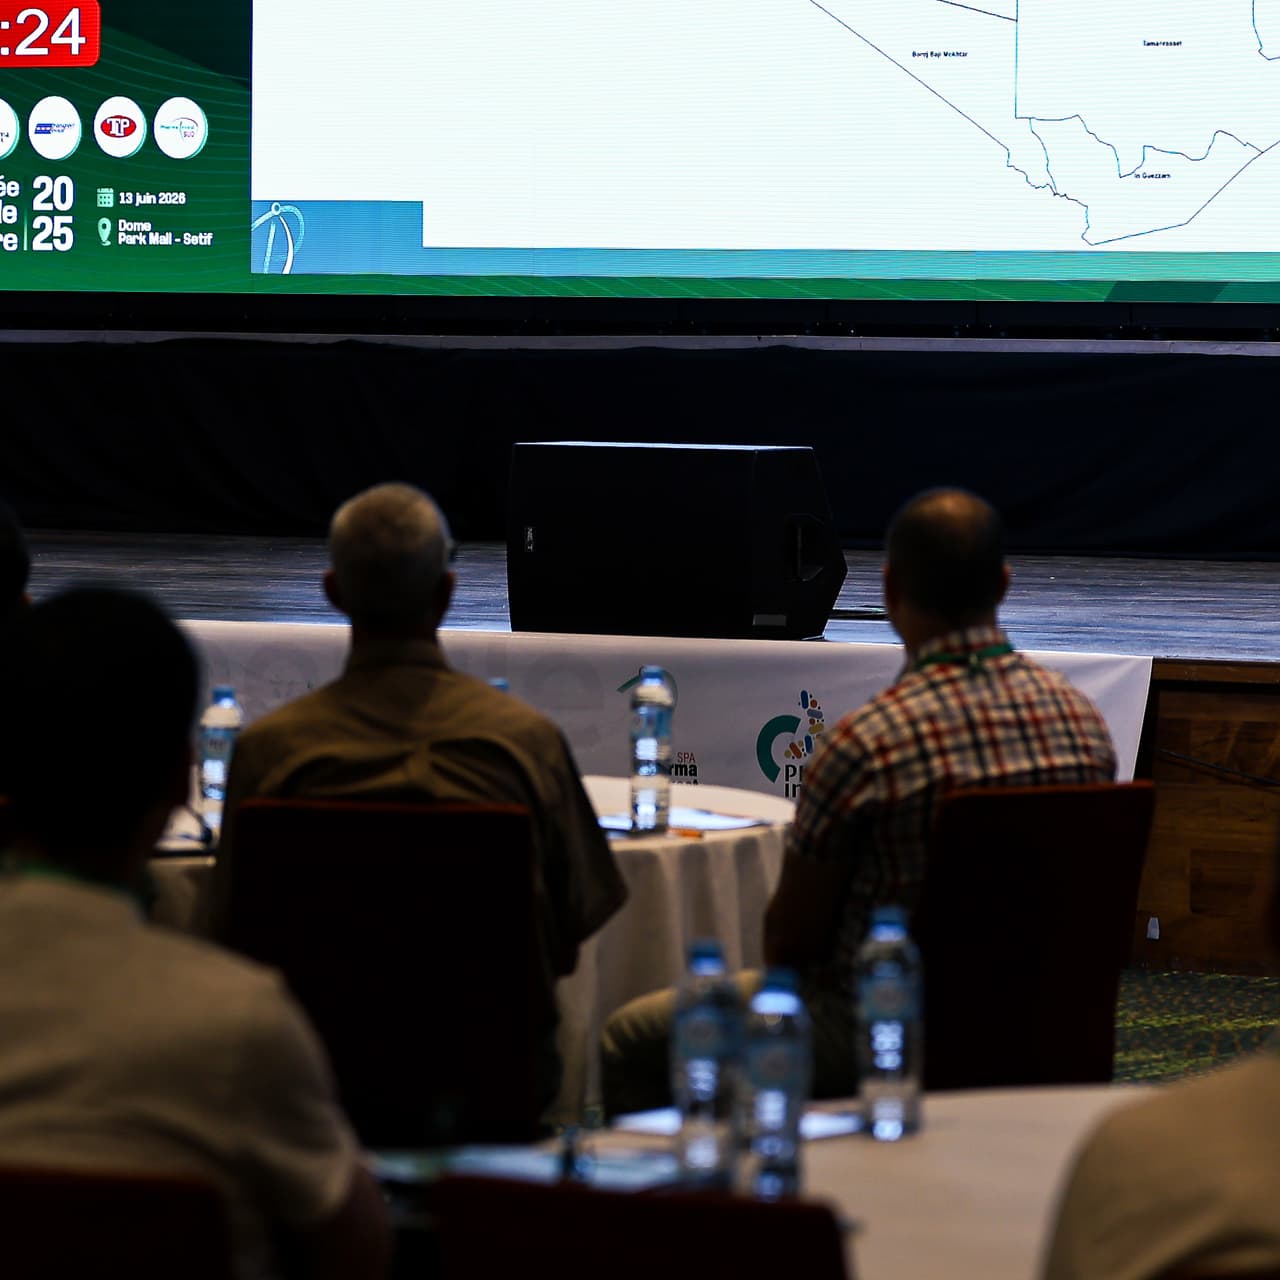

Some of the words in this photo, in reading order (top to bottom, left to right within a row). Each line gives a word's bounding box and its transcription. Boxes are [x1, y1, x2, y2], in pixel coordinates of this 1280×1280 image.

[32, 175, 74, 211] 20
[119, 192, 133, 205] 13
[135, 192, 157, 207] juin
[118, 219, 152, 232] Dome
[32, 215, 74, 252] 25
[118, 232, 147, 245] Park
[149, 232, 173, 245] Mall
[183, 232, 214, 245] Setif
[677, 751, 696, 763] SPA
[670, 764, 698, 777] rma
